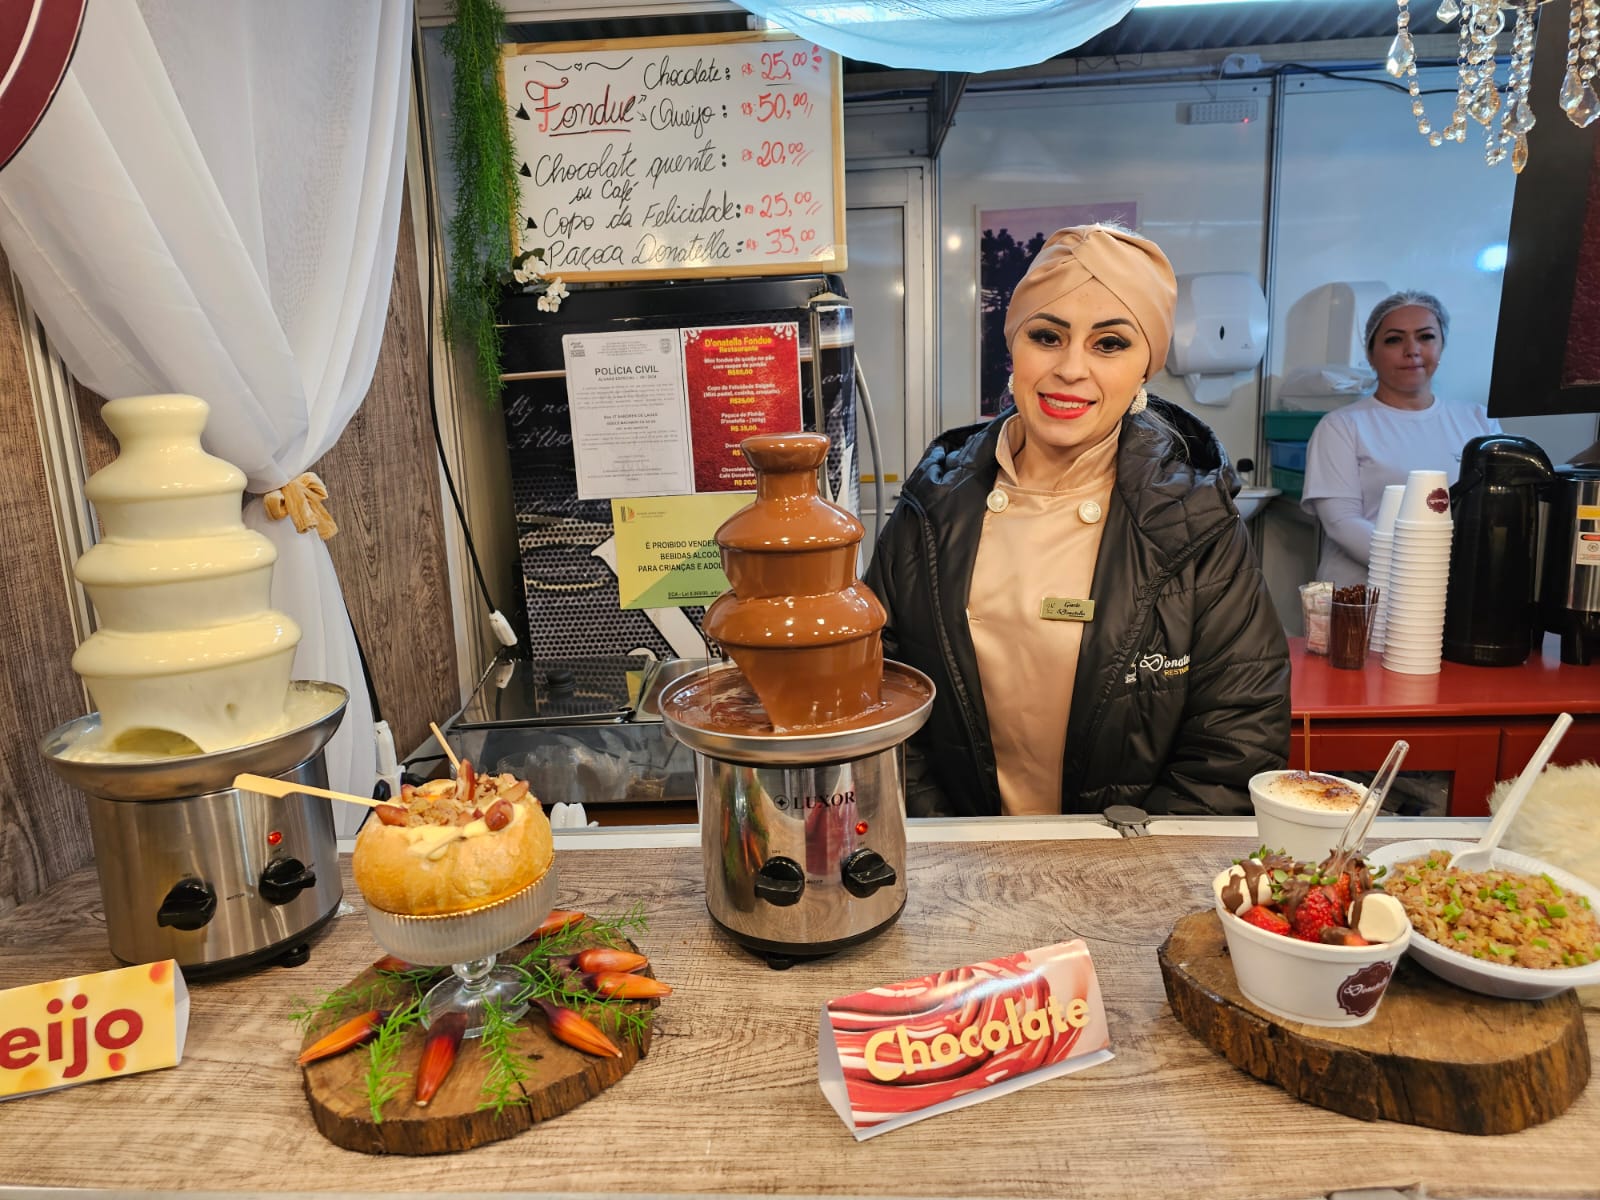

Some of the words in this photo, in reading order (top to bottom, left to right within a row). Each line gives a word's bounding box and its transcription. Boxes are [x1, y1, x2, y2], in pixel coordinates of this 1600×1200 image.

[525, 77, 637, 133] Fondue
[535, 143, 636, 187] Chocolate
[568, 187, 593, 206] ou
[543, 207, 595, 240] Copo
[743, 335, 772, 346] Fondue
[635, 365, 659, 375] CIVIL
[652, 539, 687, 549] PROIBIDO
[660, 552, 691, 560] BEBIDAS
[638, 564, 657, 573] PARA
[658, 562, 696, 573] CRIANÇAS
[792, 790, 856, 810] LUXOR
[864, 995, 1091, 1082] Chocolate
